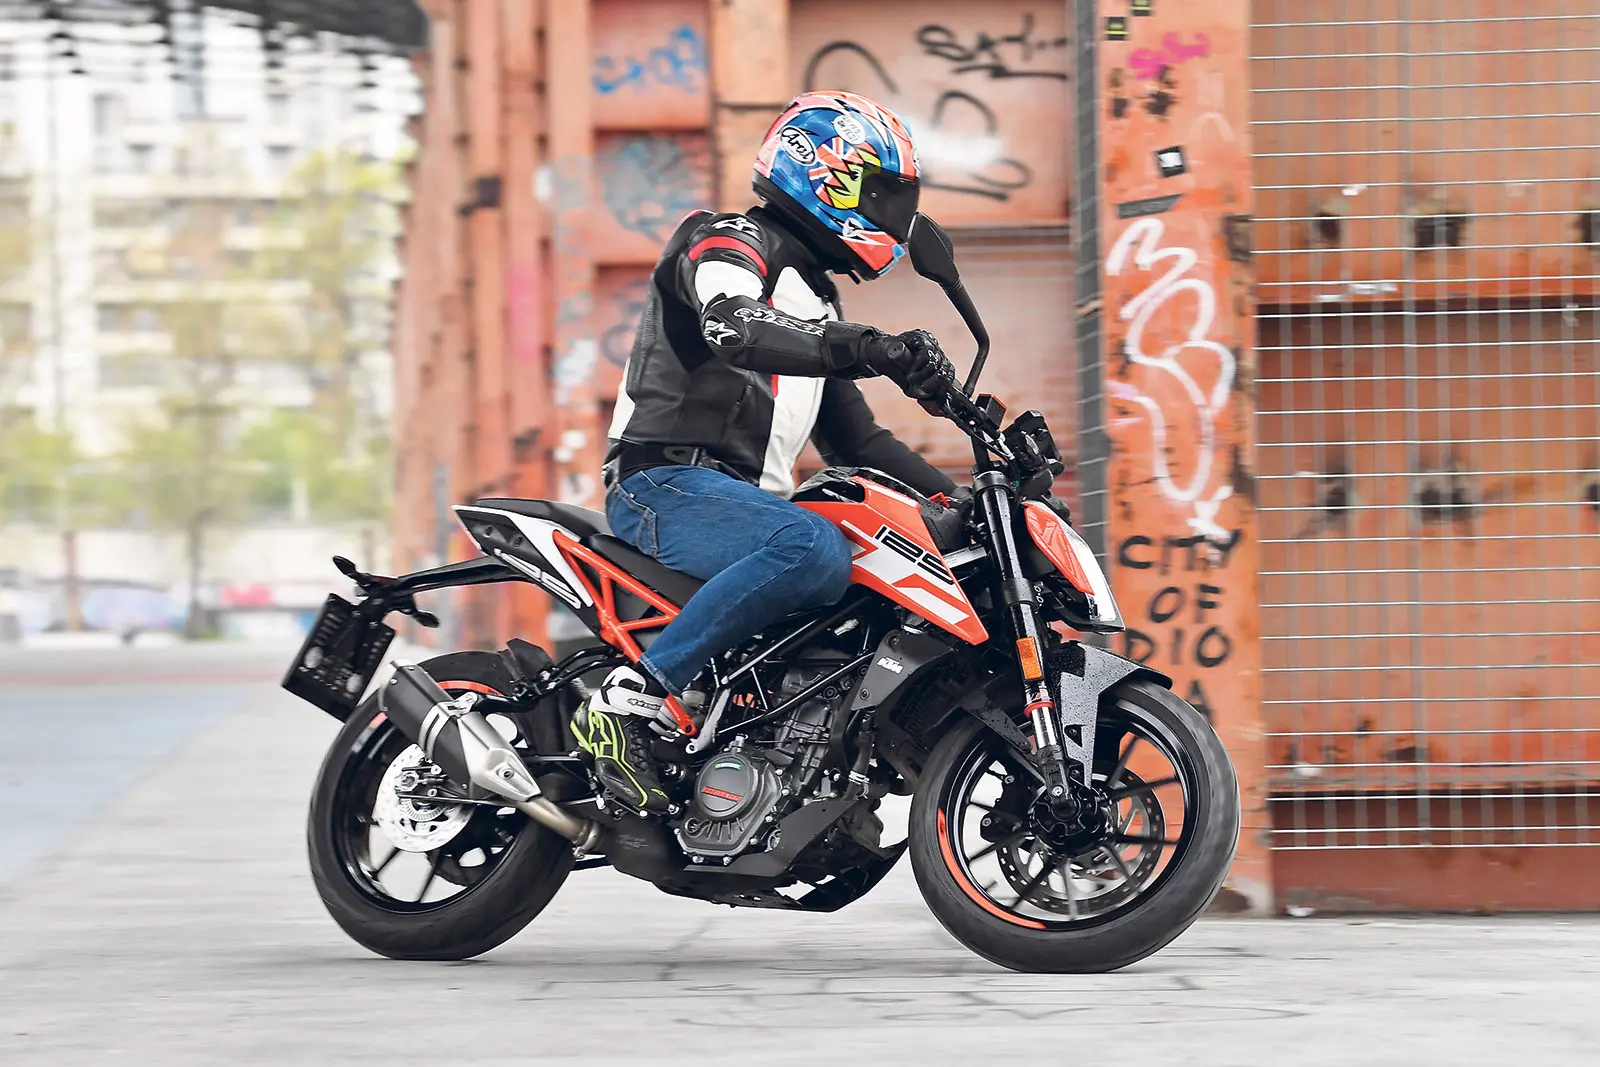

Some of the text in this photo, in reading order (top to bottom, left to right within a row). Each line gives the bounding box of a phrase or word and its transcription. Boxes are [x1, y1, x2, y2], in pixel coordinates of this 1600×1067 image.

[782, 132, 813, 160] Arai
[874, 525, 954, 585] 125
[1149, 583, 1222, 624] OF
[876, 657, 904, 674] KTM
